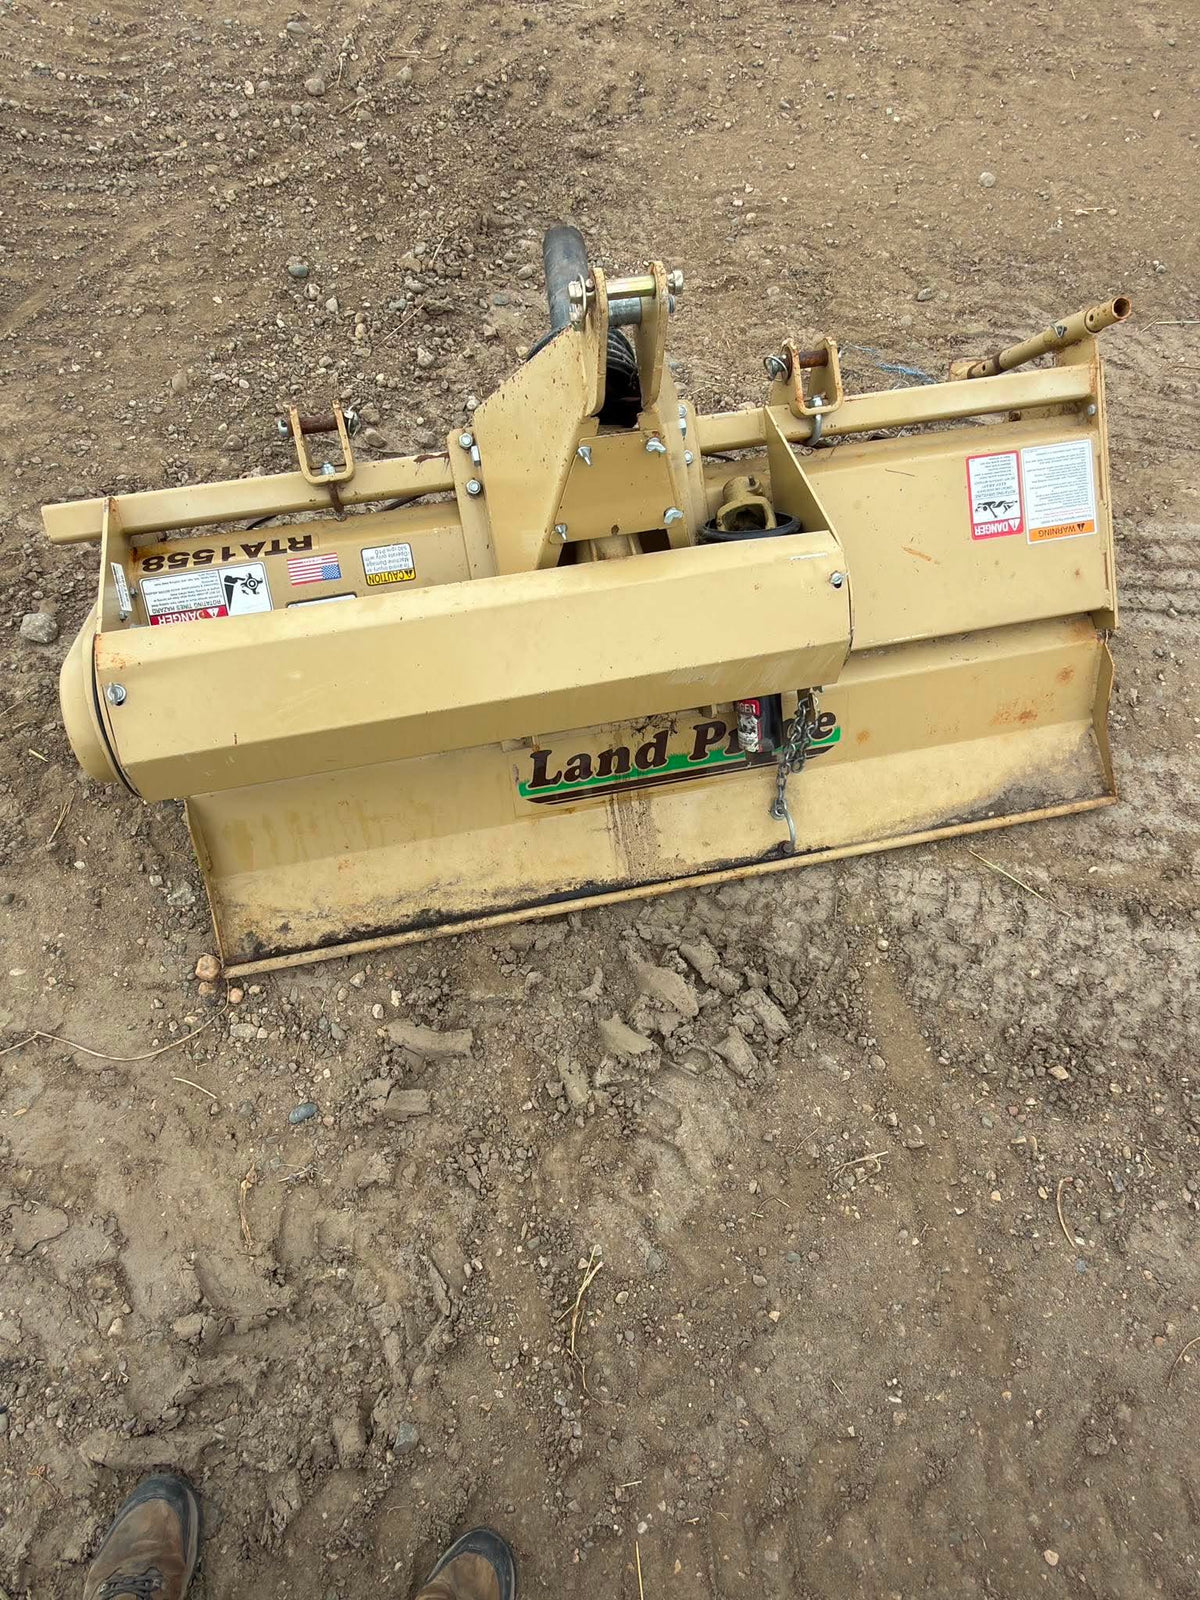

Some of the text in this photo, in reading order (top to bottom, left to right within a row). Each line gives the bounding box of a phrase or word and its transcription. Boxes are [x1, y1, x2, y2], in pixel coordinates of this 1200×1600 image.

[974, 521, 1009, 536] DANGER
[1038, 525, 1076, 537] WARNING
[142, 535, 313, 573] RTA1558
[368, 571, 405, 584] CAUTION
[151, 605, 176, 614] HAZARD
[194, 600, 222, 609] ROTATING
[158, 611, 205, 625] DANGER
[527, 710, 838, 789] Land Pre
